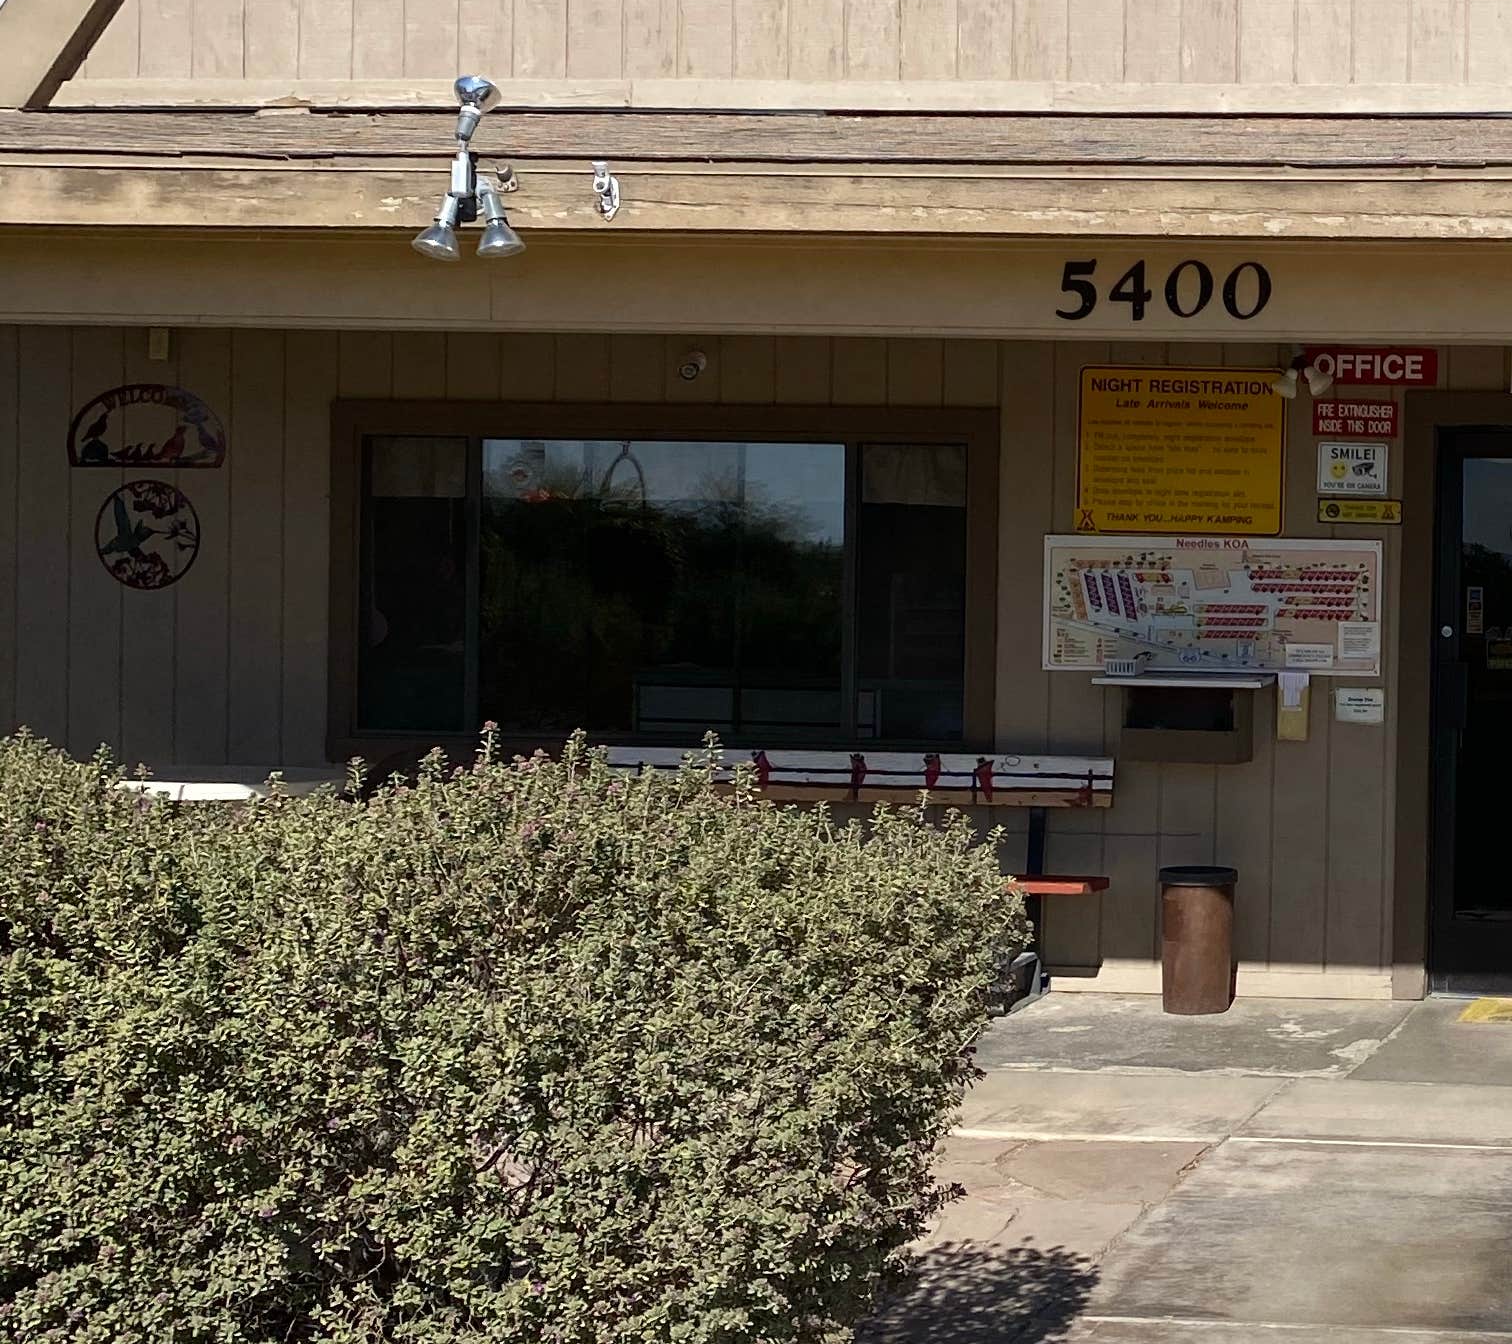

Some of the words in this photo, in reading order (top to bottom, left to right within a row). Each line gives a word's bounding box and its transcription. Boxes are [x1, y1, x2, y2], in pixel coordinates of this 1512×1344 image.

[1055, 258, 1272, 321] 5400
[1313, 353, 1424, 381] OFFICE
[1091, 378, 1142, 392] NIGHT
[1149, 379, 1274, 396] REGISTRATION
[1116, 399, 1140, 409] Late
[1147, 399, 1191, 410] Arrivals
[1198, 400, 1249, 411] Welcome
[1317, 403, 1335, 417] FIRE
[1339, 404, 1393, 419] EXTINGUISHER
[1319, 420, 1343, 433] INSIDE
[1347, 420, 1364, 433] THIS
[1368, 421, 1392, 434] DOOR
[1106, 513, 1139, 522] THANK
[1207, 515, 1253, 525] KAMPING
[1176, 539, 1220, 549] Needles
[1224, 539, 1249, 549] KOA
